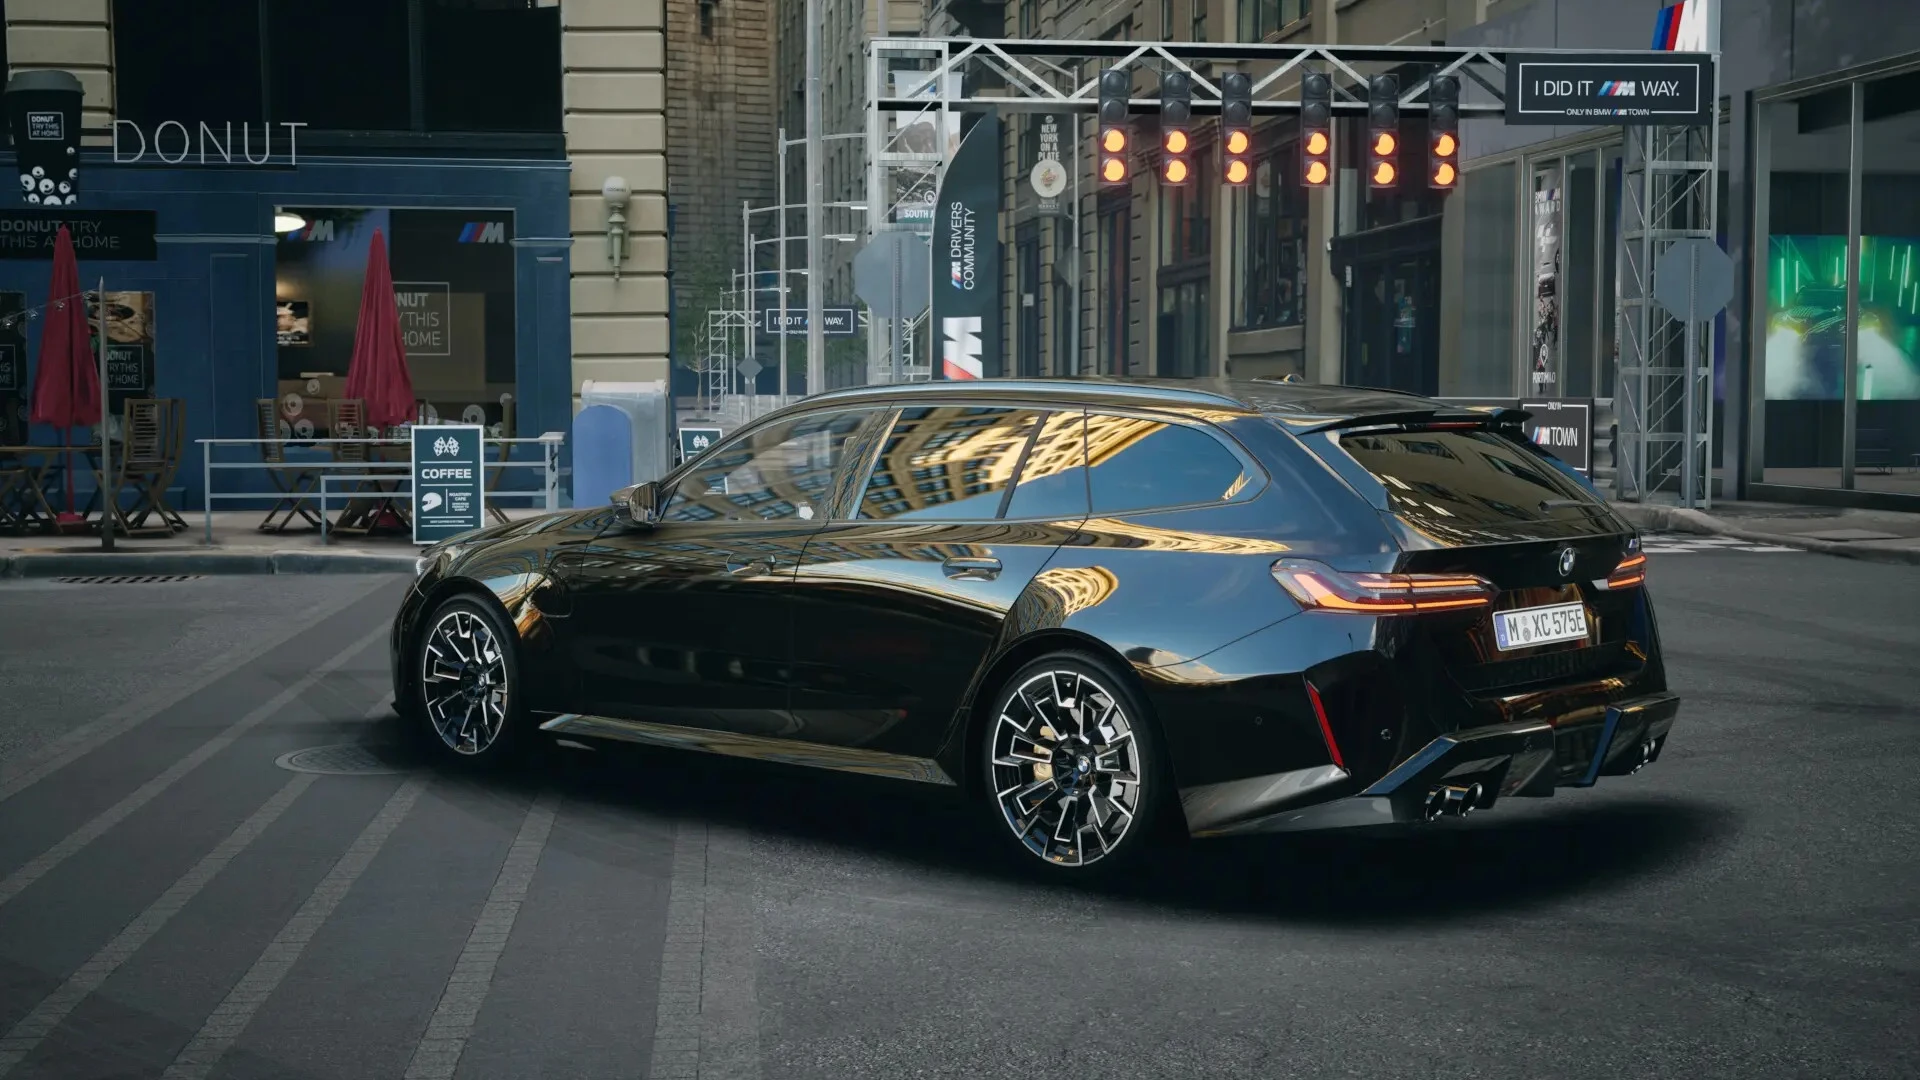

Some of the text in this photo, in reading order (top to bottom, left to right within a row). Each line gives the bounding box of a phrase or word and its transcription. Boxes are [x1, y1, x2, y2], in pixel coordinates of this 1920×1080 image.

[1535, 80, 1539, 96] I
[1543, 80, 1573, 96] DID
[1578, 80, 1594, 96] IT
[1641, 80, 1680, 96] WAY.
[1566, 108, 1584, 116] ONLY
[1585, 108, 1593, 116] IN
[1593, 108, 1612, 116] BMW
[1627, 108, 1650, 116] TOWN
[31, 115, 54, 123] DONUT
[1041, 123, 1058, 133] NEW
[112, 119, 308, 166] DONUT
[1039, 133, 1059, 142] YORK
[1040, 142, 1058, 152] ON A
[1038, 151, 1060, 161] PLATE
[904, 208, 928, 219] SOUTH
[1, 219, 102, 233] DONUT TRY
[950, 201, 963, 258] DRIVERS
[0, 235, 37, 248] THIS
[43, 235, 57, 248] A
[963, 208, 976, 290] COMMUNITY
[394, 292, 429, 307] NUT
[405, 311, 440, 327] THIS
[794, 316, 803, 325] IT
[824, 316, 844, 326] WAY.
[120, 362, 138, 373] THIS
[115, 374, 140, 384] HOME
[1550, 426, 1578, 447] TOWN
[421, 468, 472, 479] COFFEE
[1507, 617, 1520, 642] M
[1532, 612, 1551, 638] XC
[1552, 608, 1585, 635] 575E
